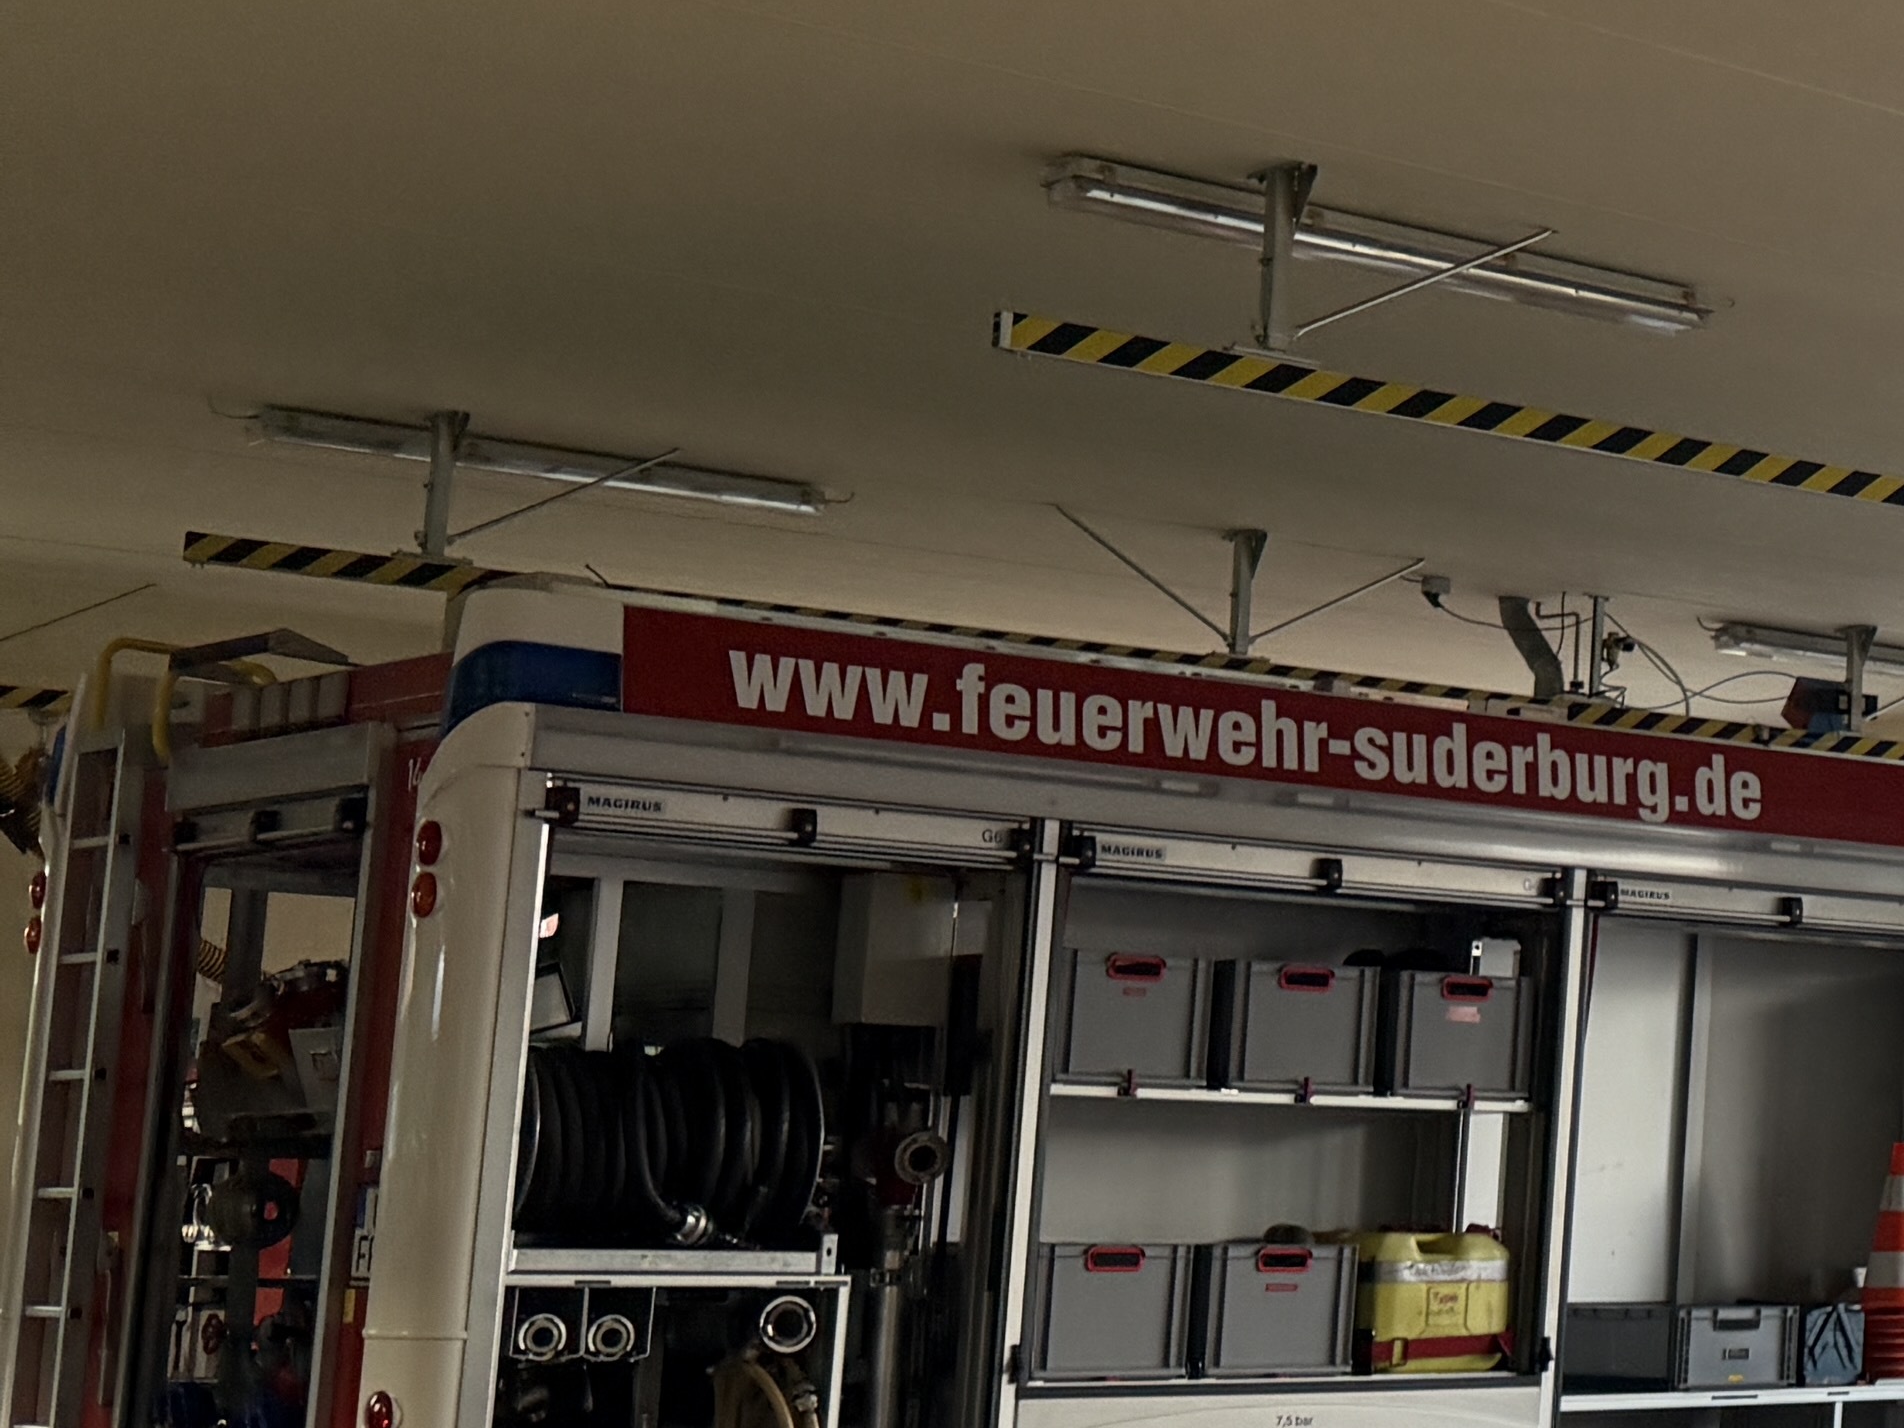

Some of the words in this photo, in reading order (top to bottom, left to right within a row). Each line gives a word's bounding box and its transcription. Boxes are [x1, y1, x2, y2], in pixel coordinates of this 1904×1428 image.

[728, 649, 1762, 824] www.feuerwehr-suderburg.de
[587, 794, 663, 813] MAGIRUS
[1101, 843, 1163, 860] MAGIRUS
[1620, 887, 1670, 901] MAGIRUS
